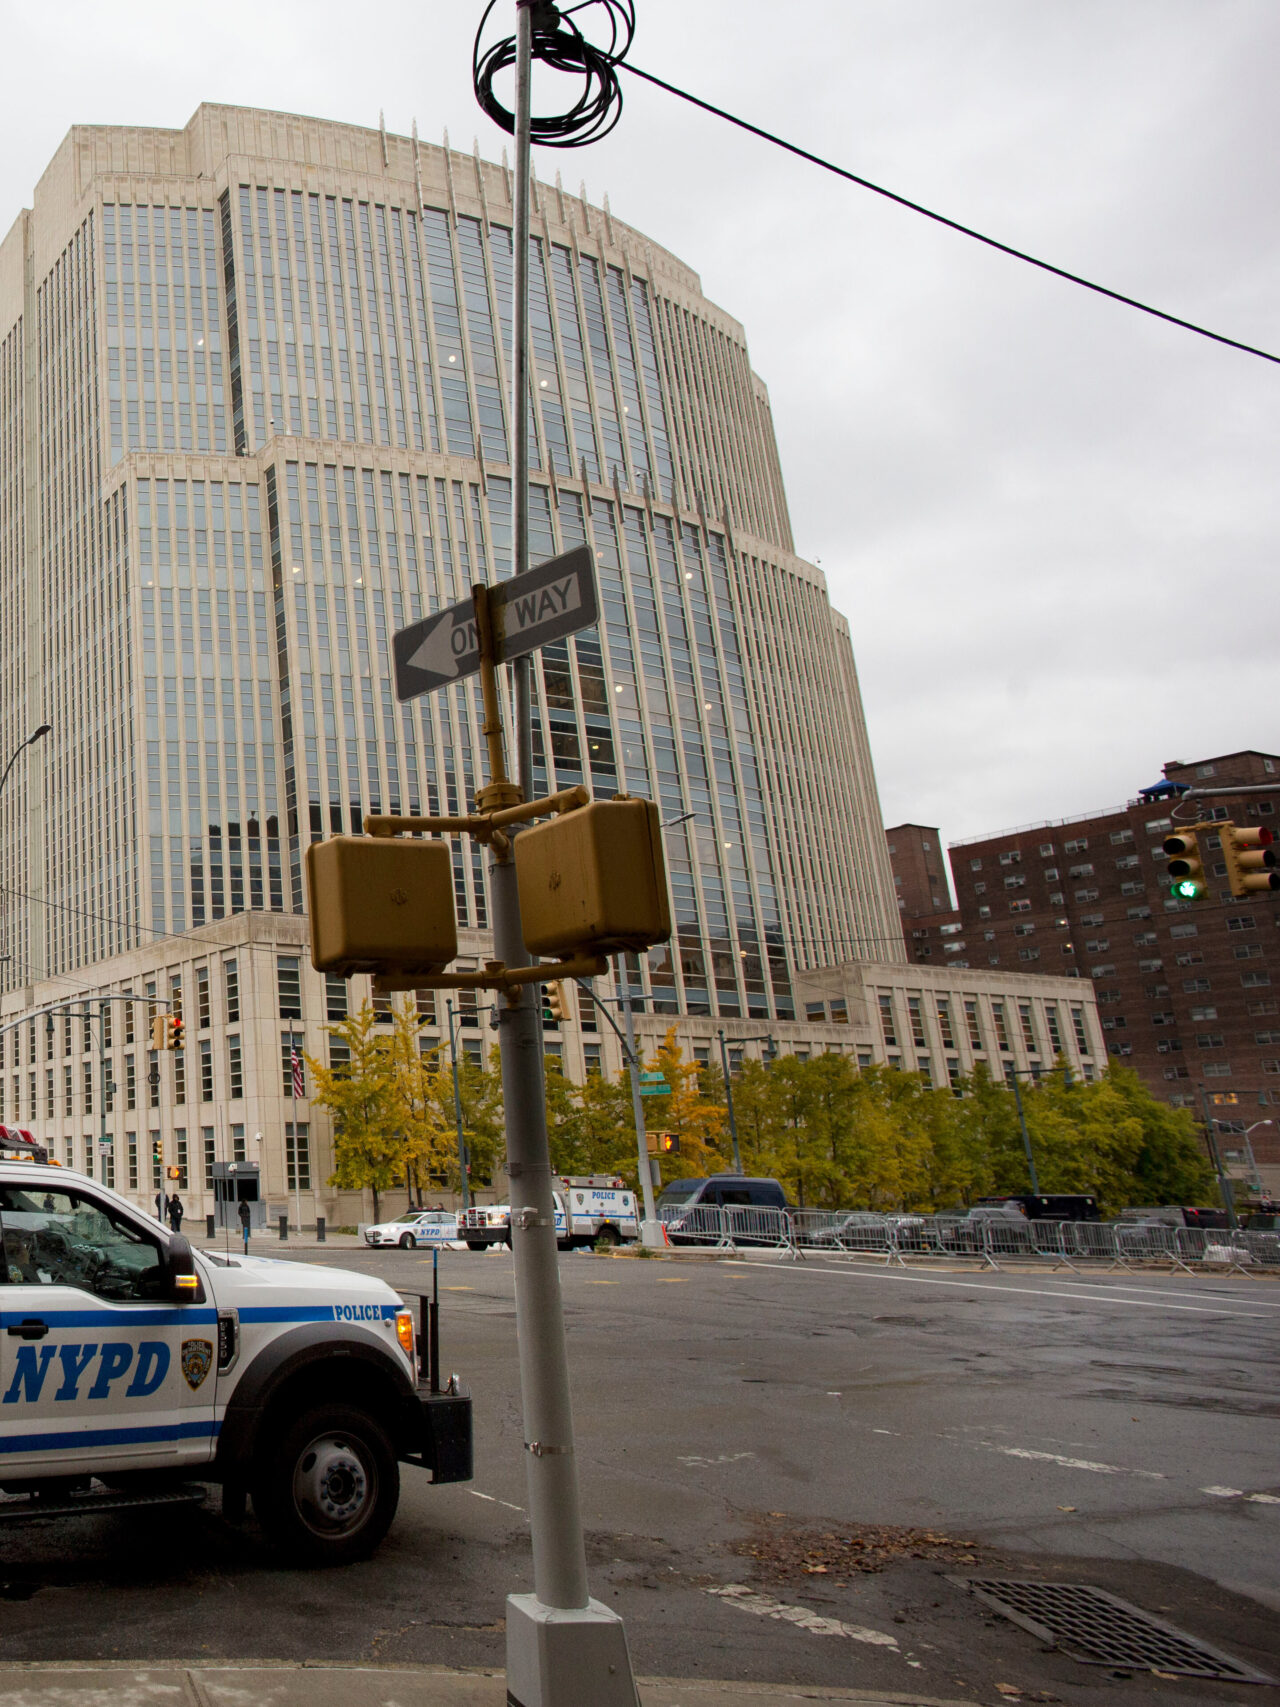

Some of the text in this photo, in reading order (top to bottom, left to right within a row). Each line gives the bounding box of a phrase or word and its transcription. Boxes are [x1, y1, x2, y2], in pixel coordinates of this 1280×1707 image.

[515, 578, 573, 627] WAY
[592, 1191, 616, 1200] POLICE
[420, 1228, 440, 1236] NYPD
[334, 1304, 381, 1321] POLICE
[2, 1341, 171, 1404] NYPD
